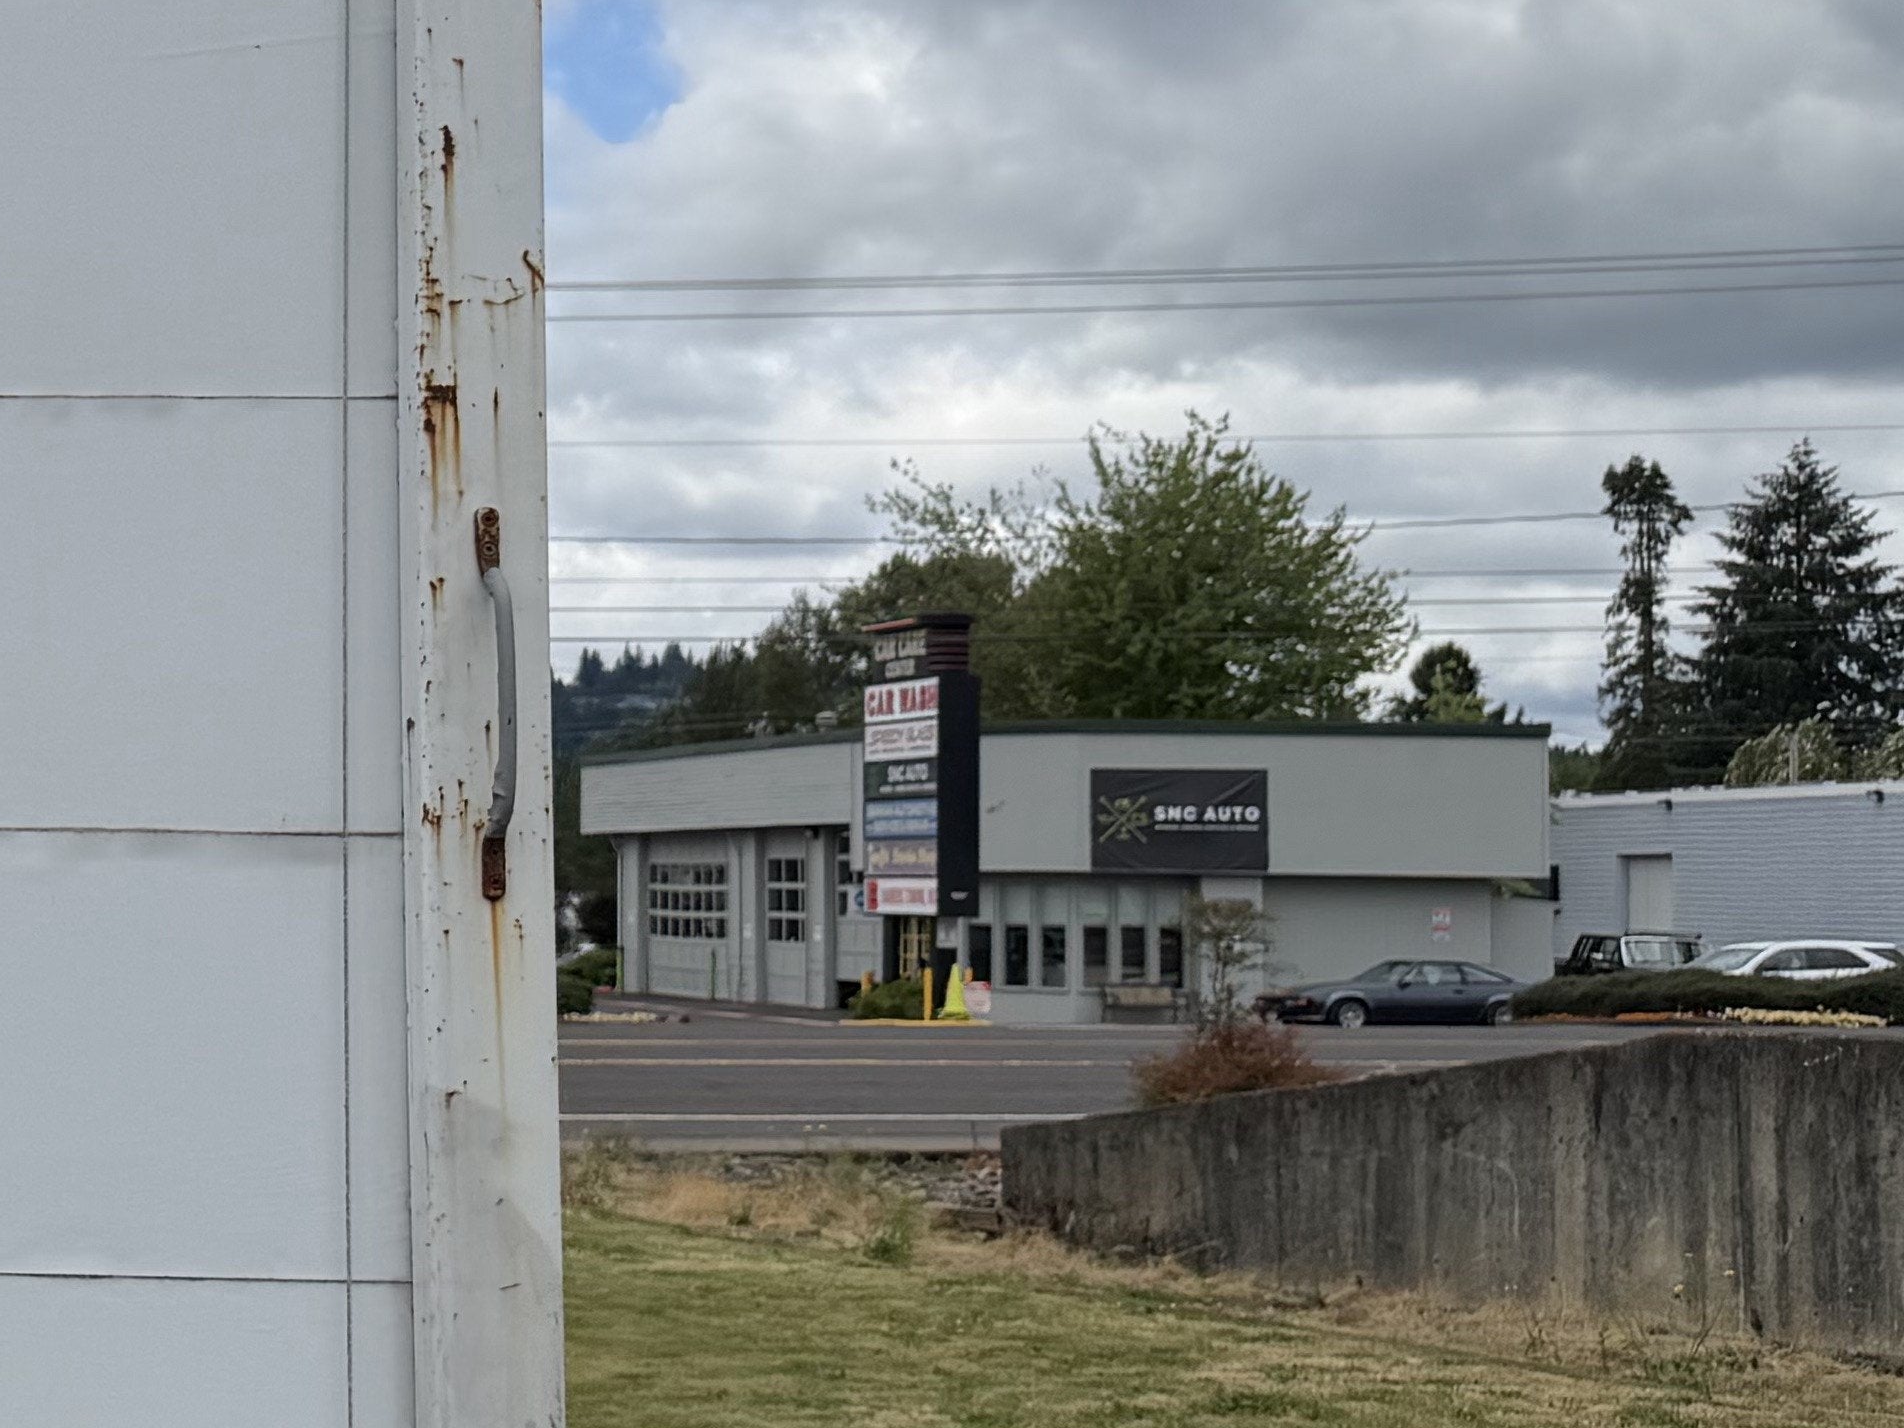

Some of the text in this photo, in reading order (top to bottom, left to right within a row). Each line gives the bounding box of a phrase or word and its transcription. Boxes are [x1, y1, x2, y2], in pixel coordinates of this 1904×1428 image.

[866, 684, 938, 717] CAR WASH
[1153, 804, 1261, 823] SNC AUTO
